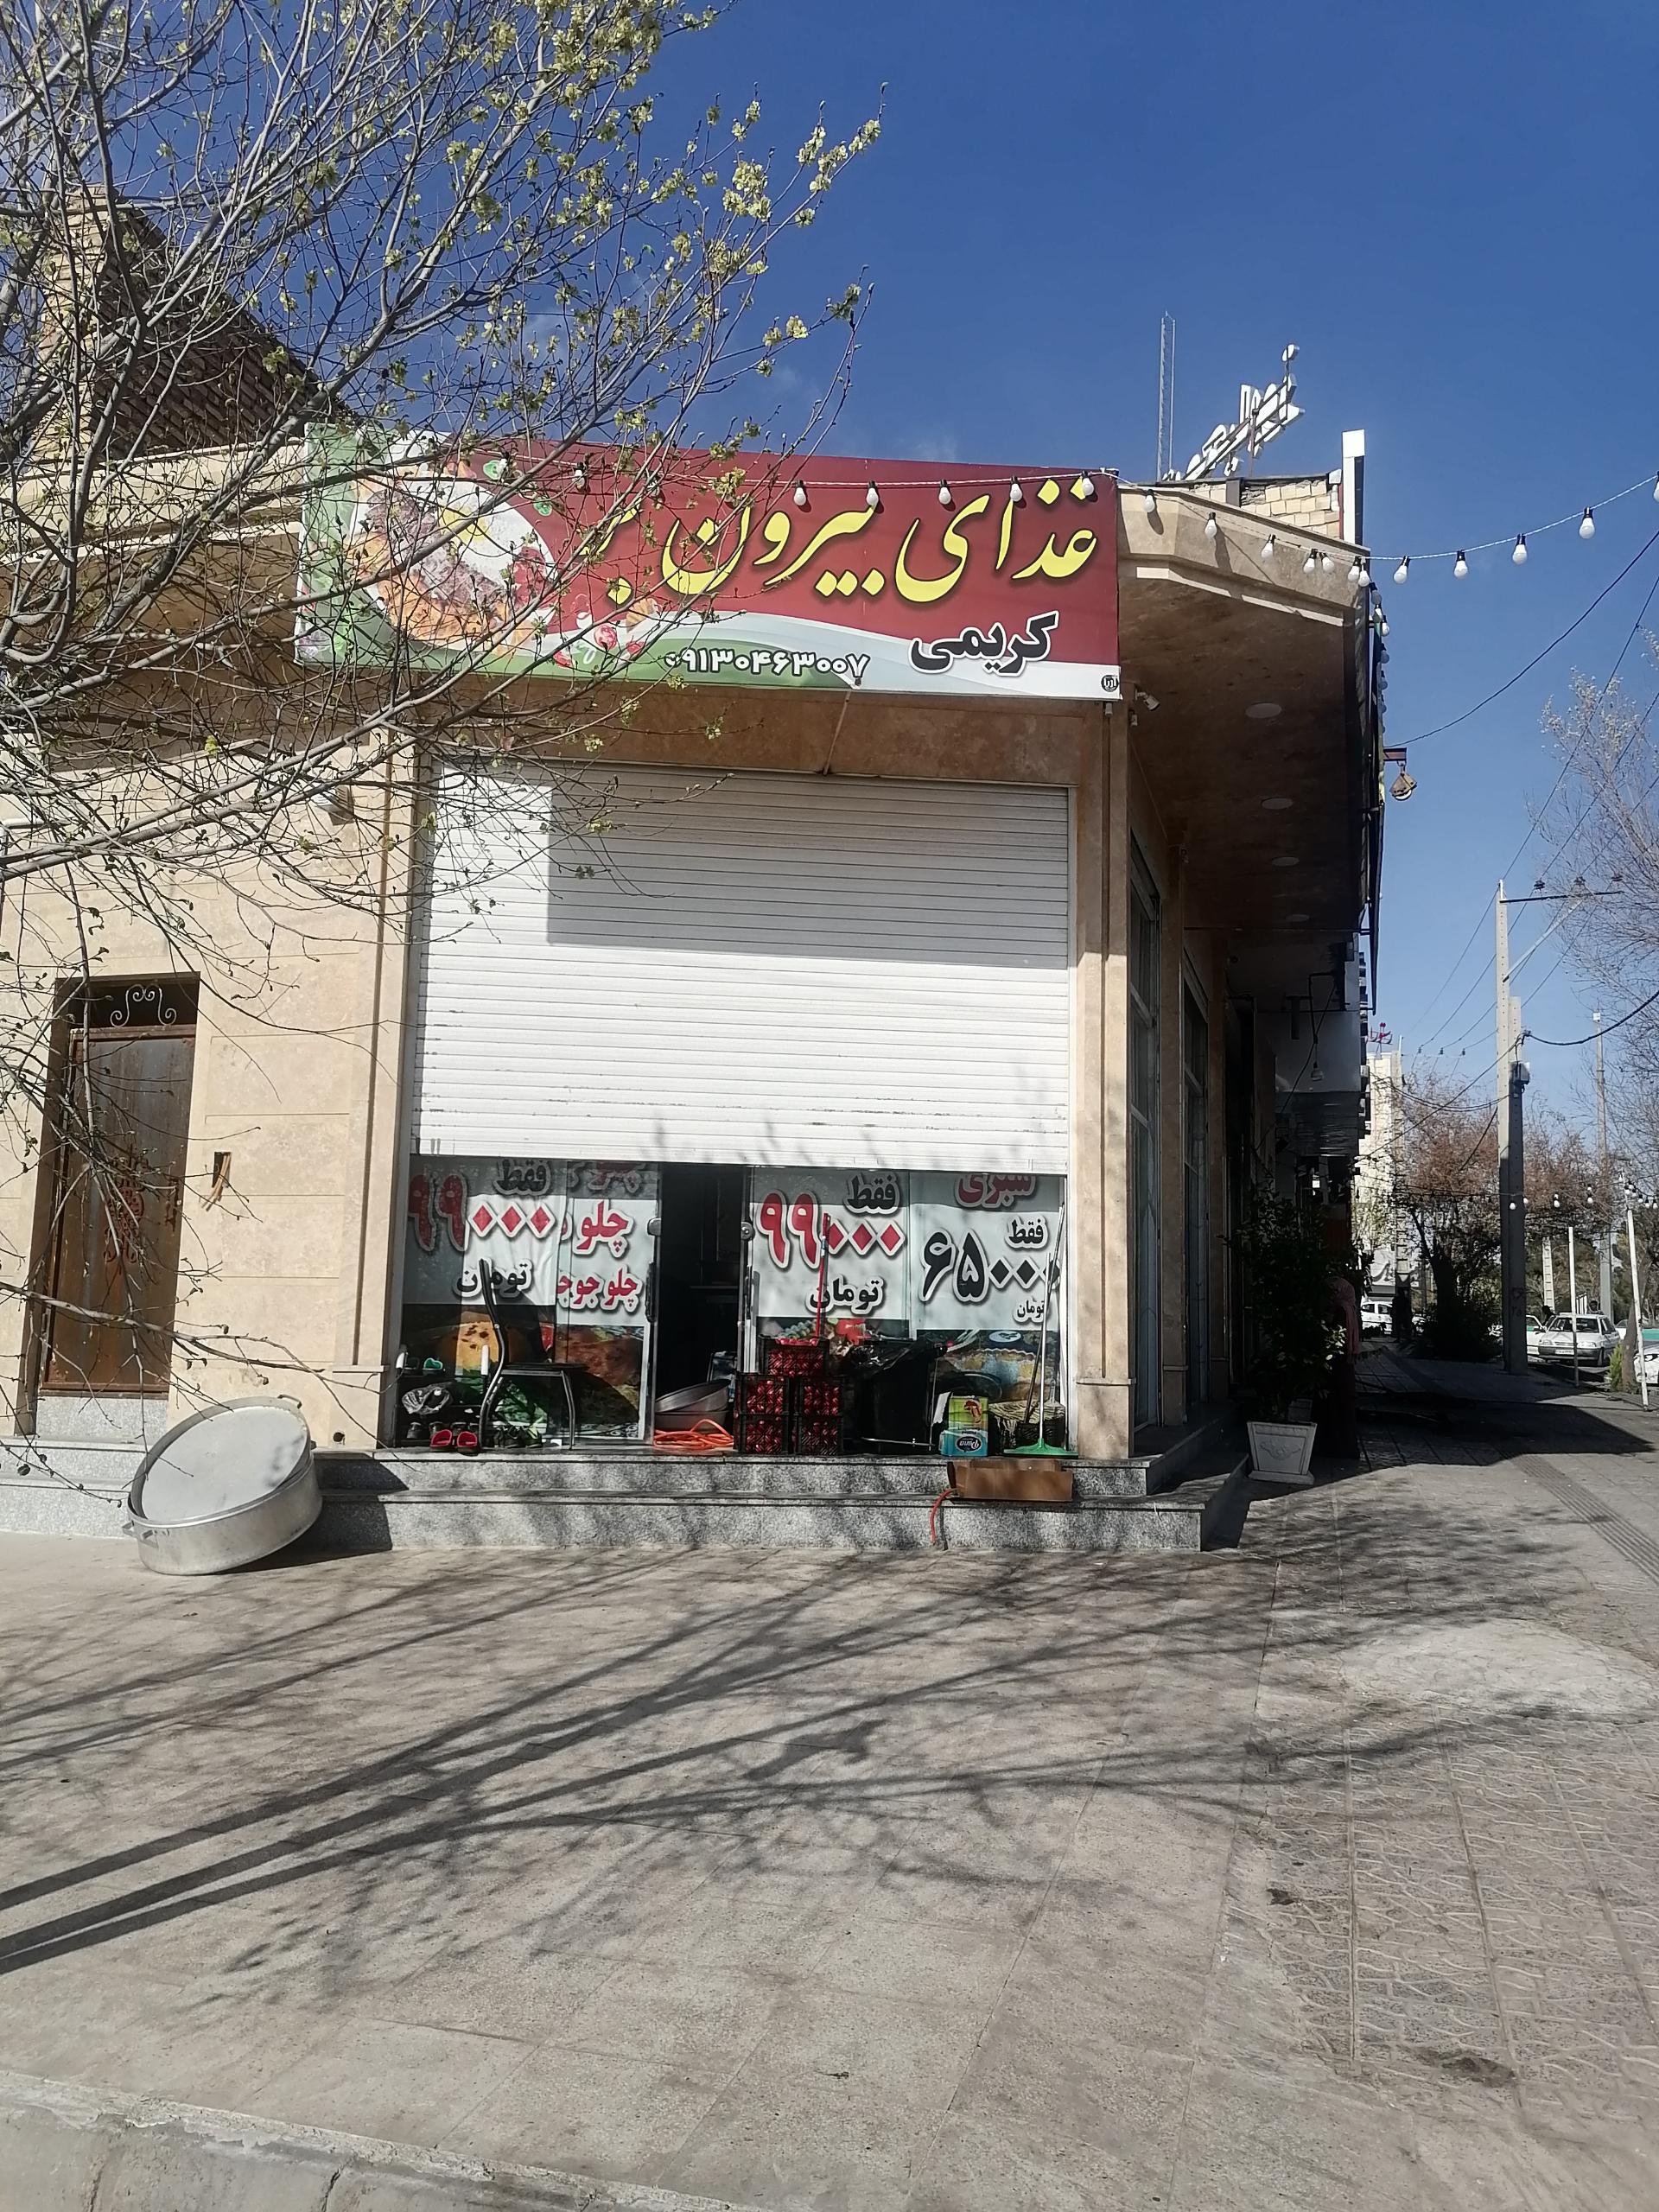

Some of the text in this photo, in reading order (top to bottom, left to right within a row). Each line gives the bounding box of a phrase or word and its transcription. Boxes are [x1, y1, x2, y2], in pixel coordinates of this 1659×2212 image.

[662, 502, 885, 594] بیرون
[895, 478, 1097, 602] غذای
[910, 612, 1058, 675] کریمی
[664, 648, 870, 679] ۰۹۱۳۰۴۶۳۰۰۷
[495, 1159, 548, 1192] فقط
[846, 1173, 897, 1211] فقط
[575, 1200, 629, 1253] چلو
[760, 1192, 901, 1265] ۹۹۰۰۰
[1007, 1218, 1045, 1244] فقط
[456, 1262, 529, 1294] تومن
[922, 1231, 1060, 1298] ۶۵۰۰۰
[556, 1268, 639, 1307] چلو جوج
[810, 1277, 880, 1310] تومان
